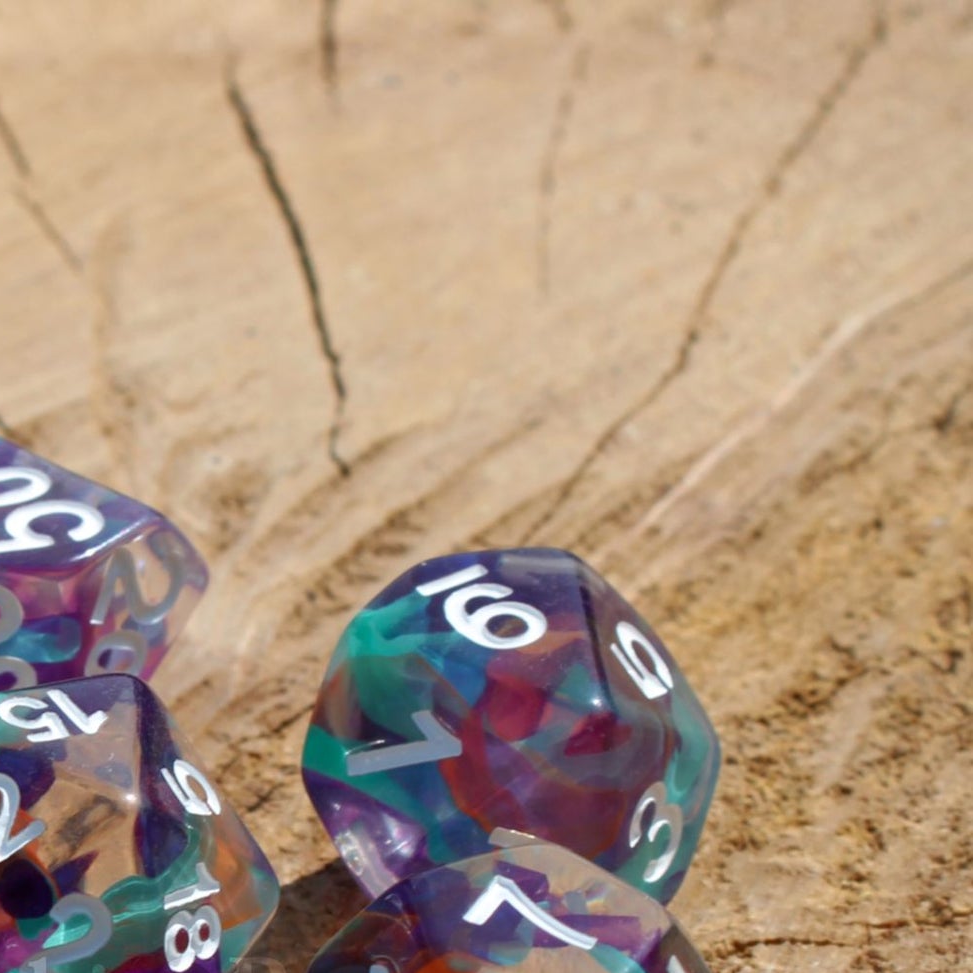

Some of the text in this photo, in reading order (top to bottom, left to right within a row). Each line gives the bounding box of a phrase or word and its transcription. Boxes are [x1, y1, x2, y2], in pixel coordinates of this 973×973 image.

[629, 781, 683, 883] 3
[163, 861, 222, 973] 18
[463, 875, 598, 951] 7
